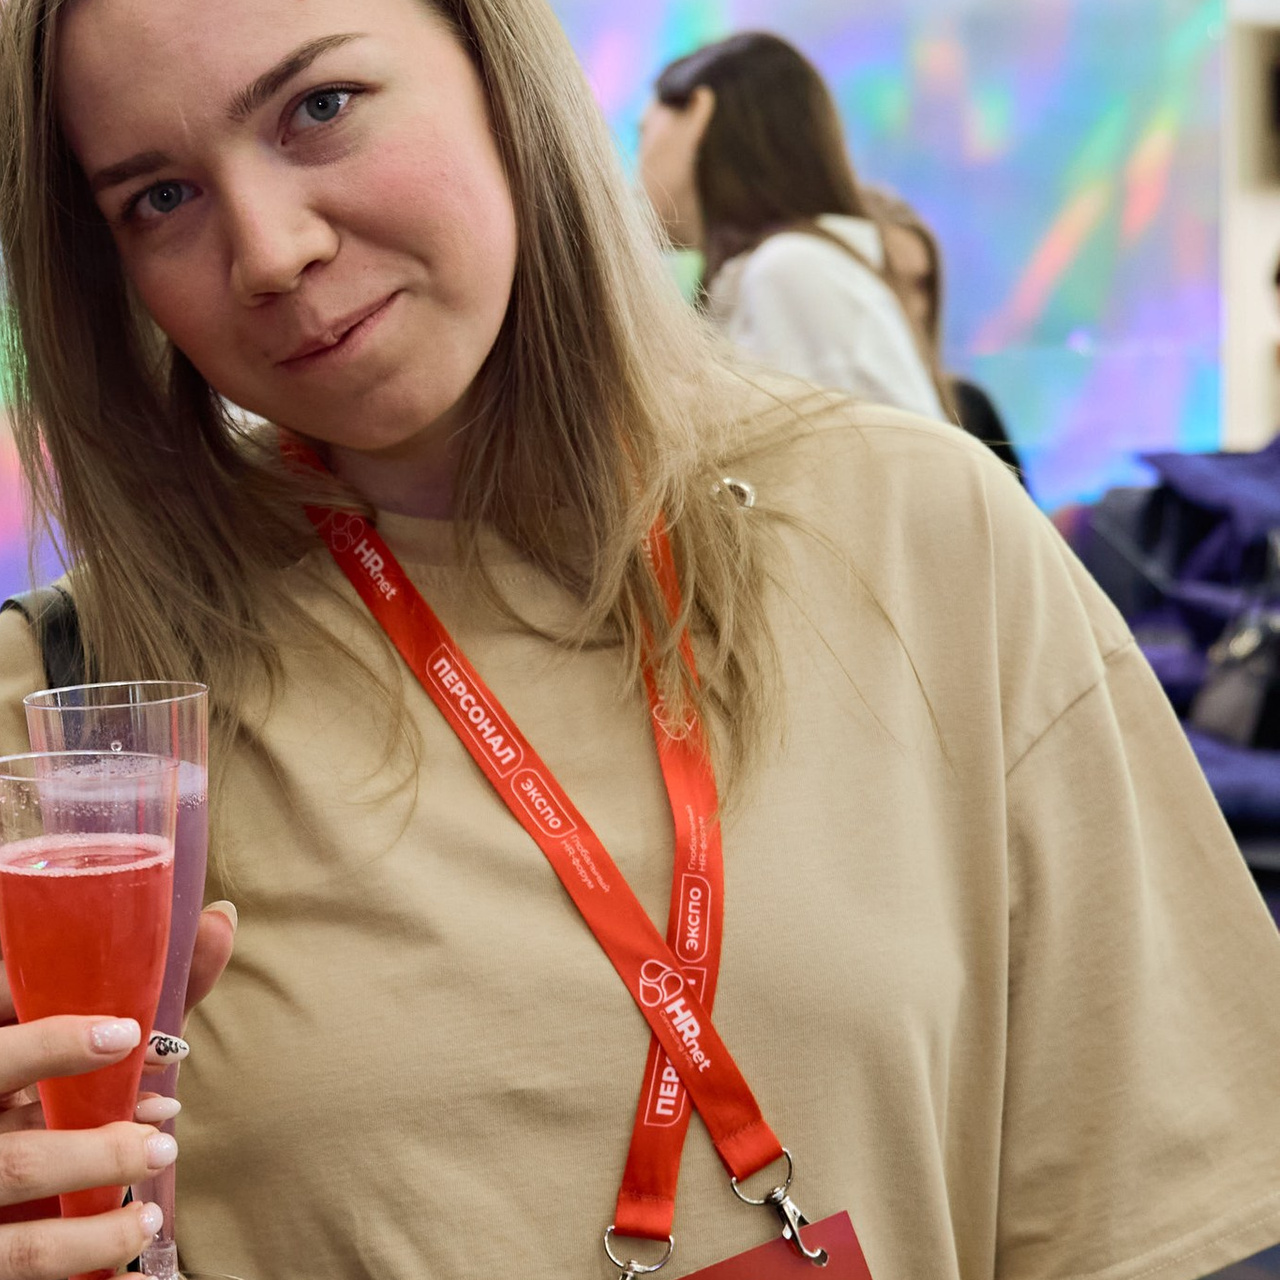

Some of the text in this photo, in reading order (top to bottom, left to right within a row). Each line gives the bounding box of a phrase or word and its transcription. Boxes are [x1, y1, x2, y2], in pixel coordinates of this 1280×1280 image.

[353, 538, 398, 602] HRnet
[432, 657, 516, 765] ПЕРСОНАЛ
[520, 777, 562, 830] ЭКСПО
[560, 839, 594, 891] HR-форум
[570, 833, 610, 893] Глобальный
[685, 886, 702, 952] ЭКСПО
[664, 996, 711, 1073] HRnet
